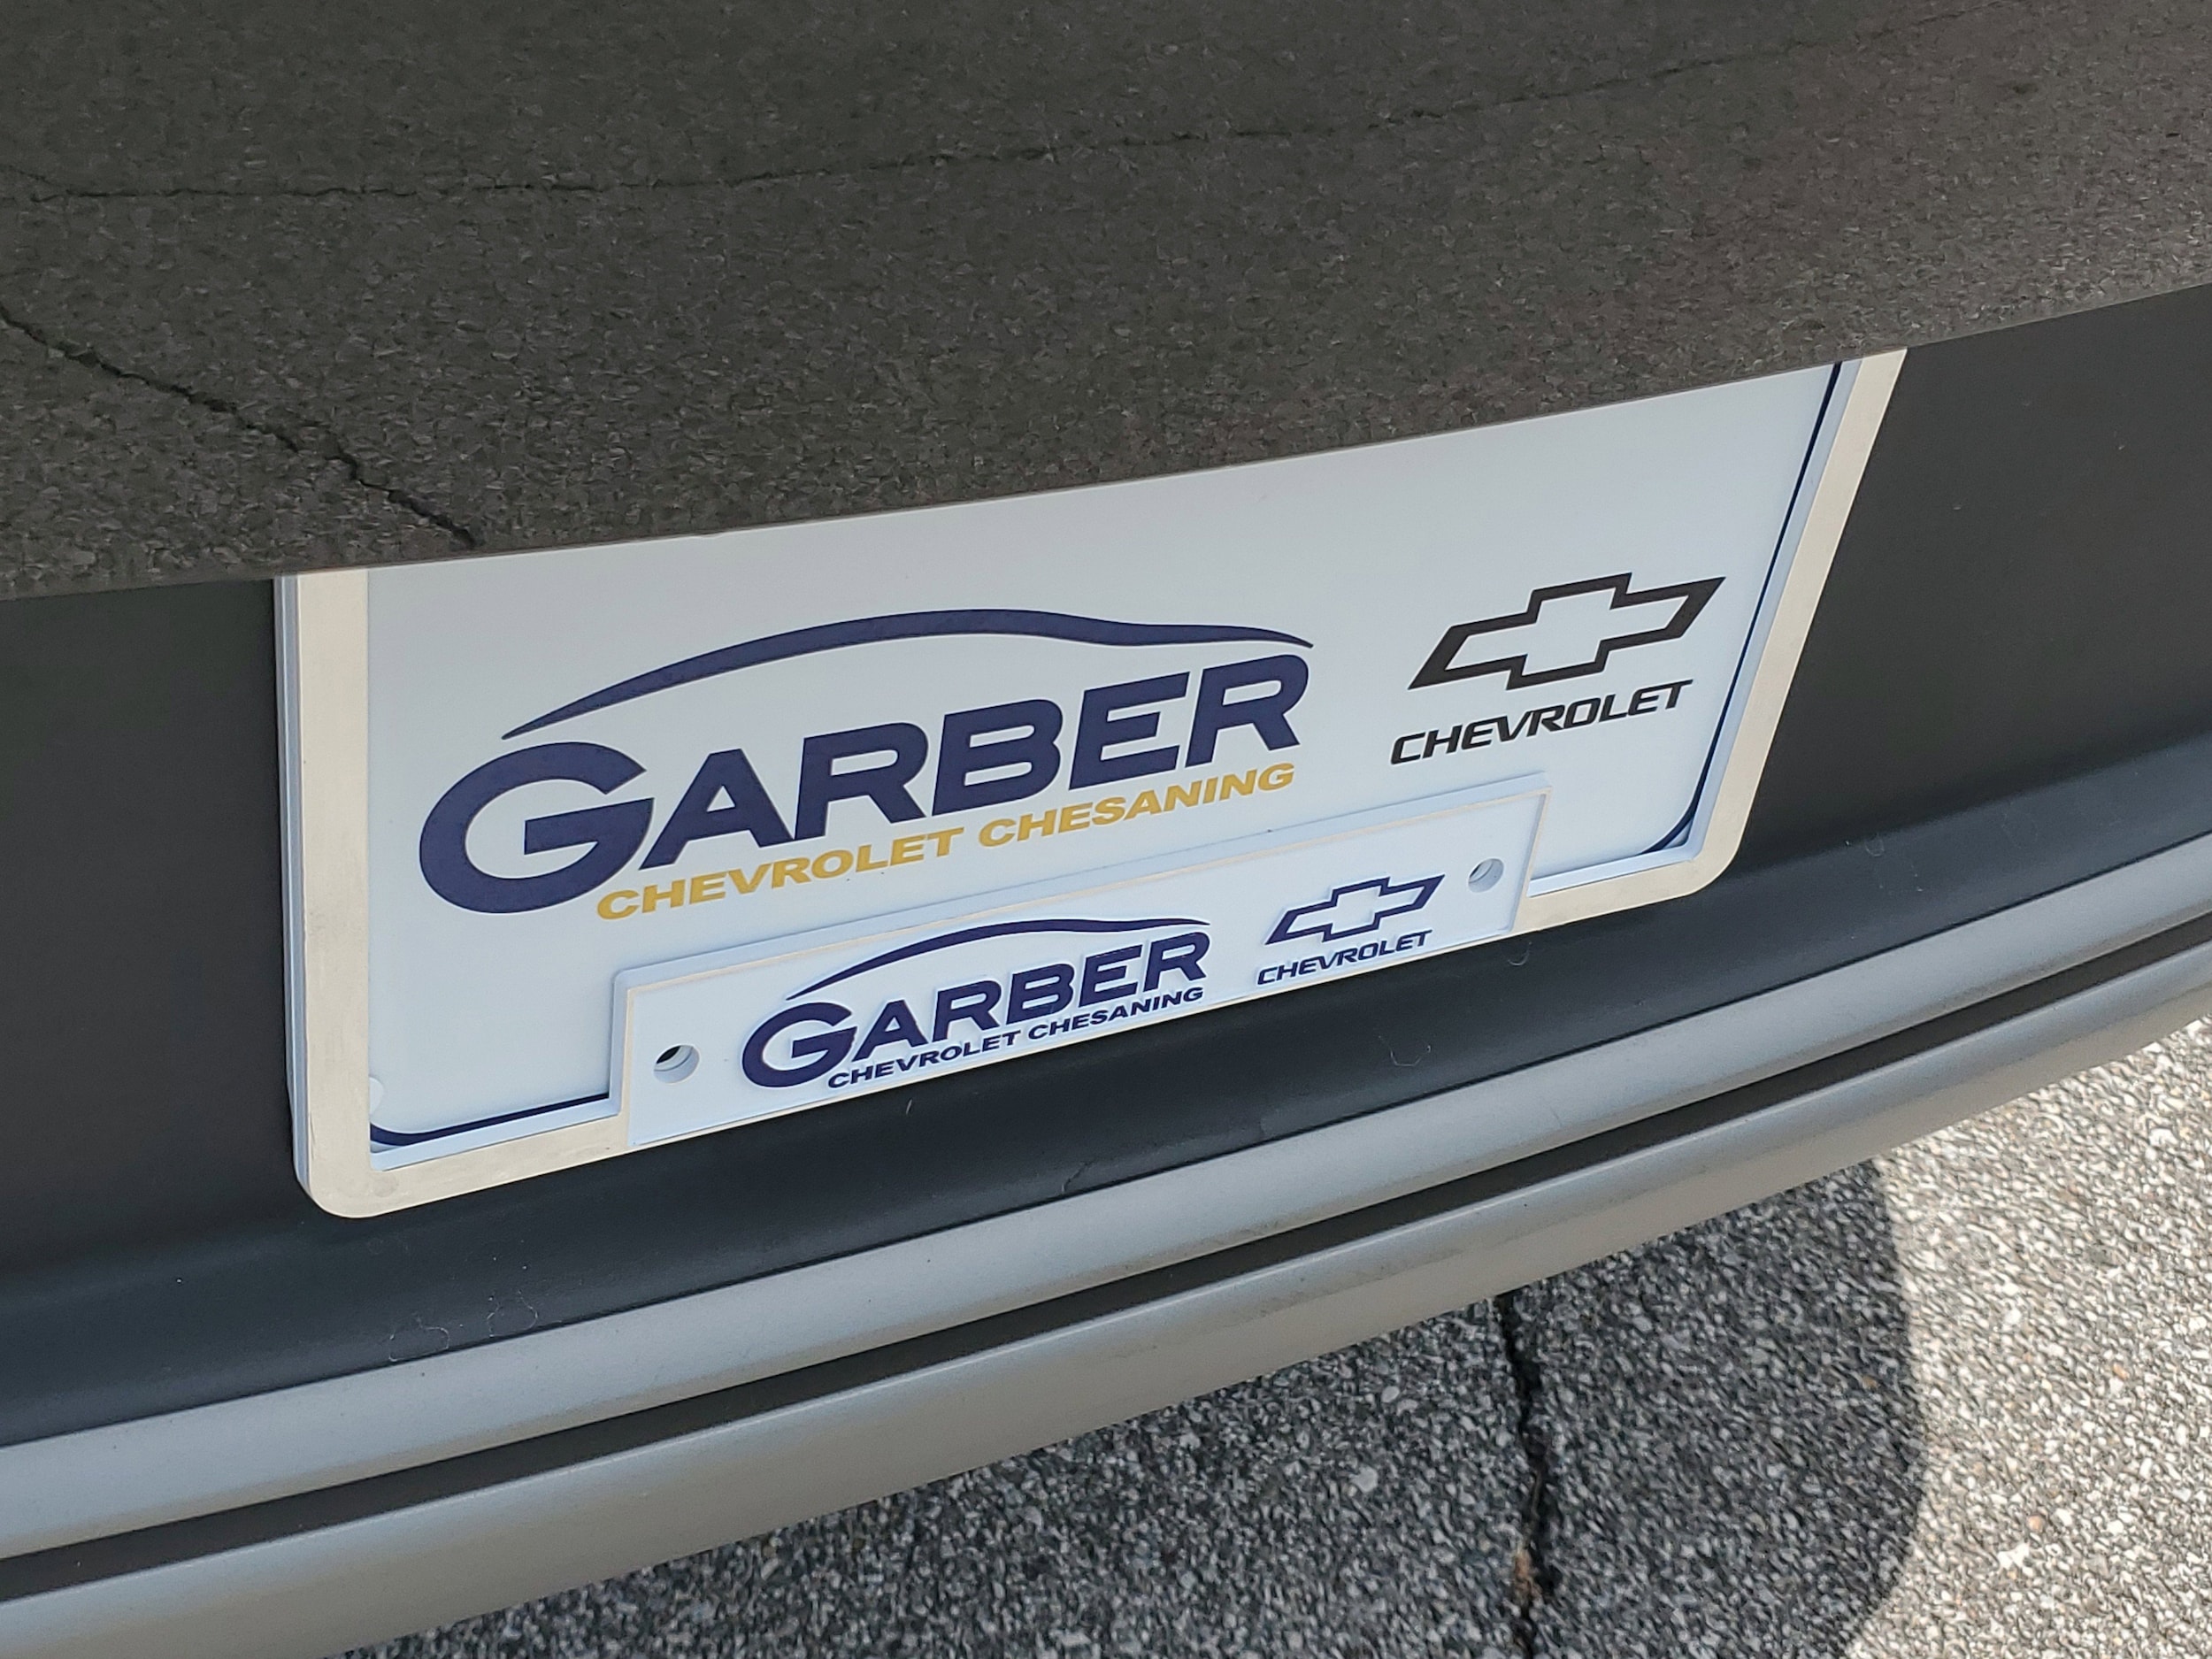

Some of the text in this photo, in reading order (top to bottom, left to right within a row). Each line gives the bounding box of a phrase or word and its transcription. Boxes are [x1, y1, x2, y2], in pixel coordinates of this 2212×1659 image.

[419, 653, 1310, 915] GARBER
[1390, 679, 1694, 764] CHEVROLET
[596, 762, 1296, 921] CHEVROLET CHESANING
[741, 930, 1212, 1090] GARBER
[1256, 930, 1432, 987] CHEVROLET
[826, 986, 1204, 1090] CHEVROLET CHESANING
